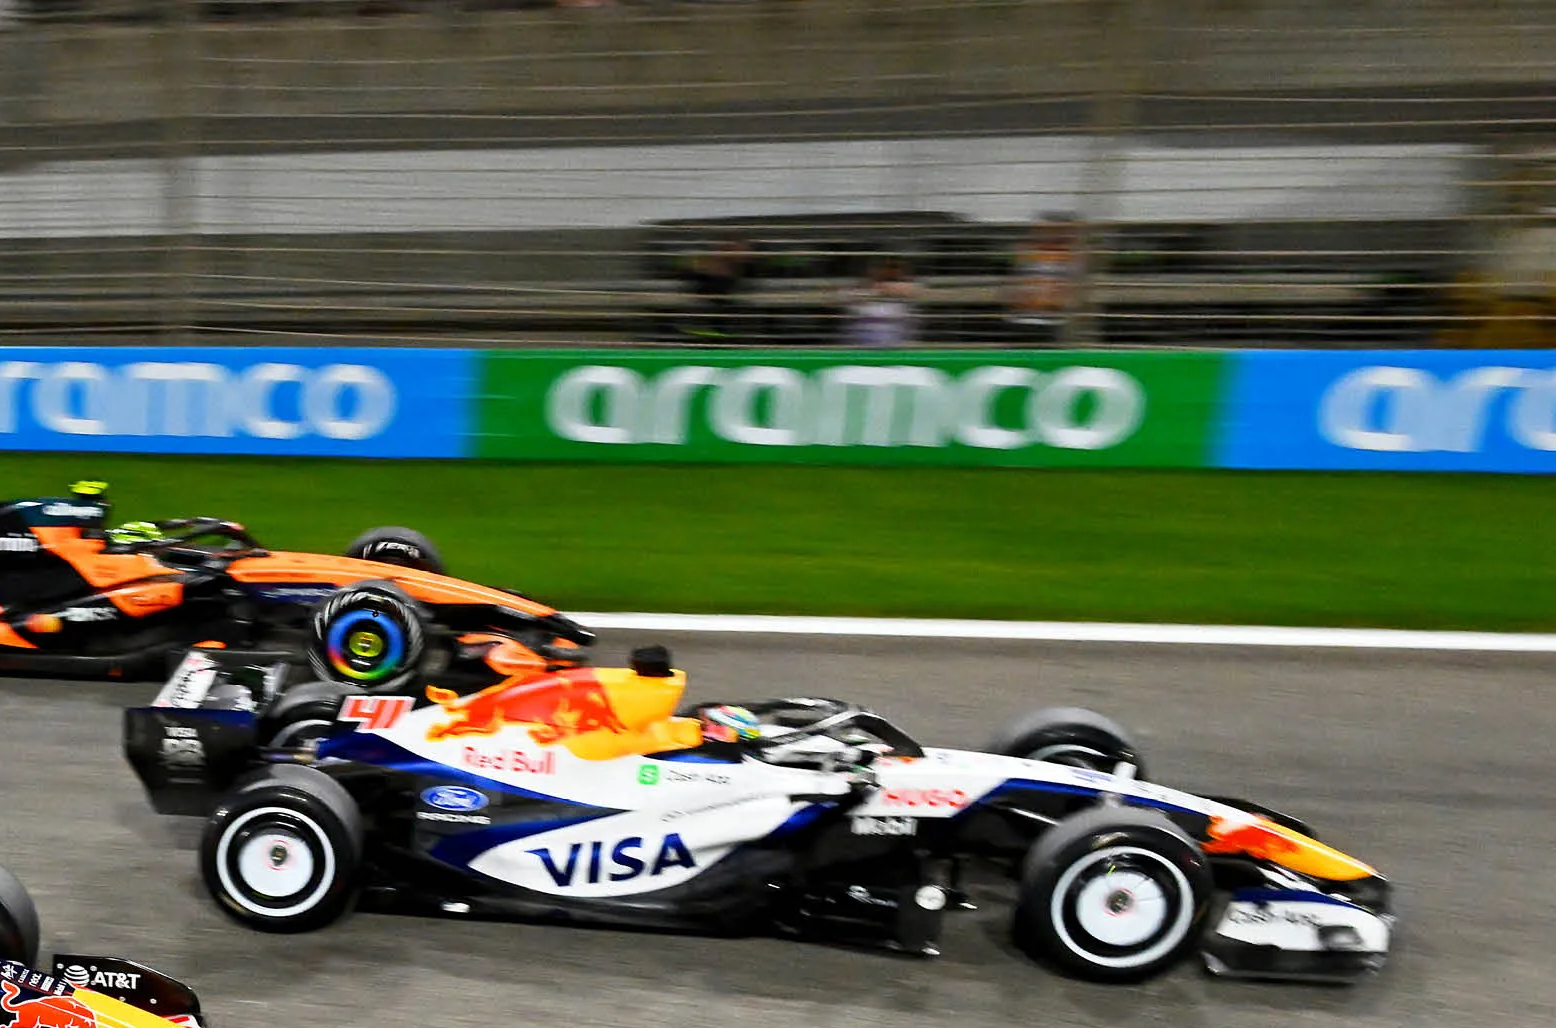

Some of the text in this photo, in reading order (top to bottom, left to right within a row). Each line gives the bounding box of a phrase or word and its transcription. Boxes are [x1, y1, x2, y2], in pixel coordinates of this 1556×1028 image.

[545, 365, 1147, 450] aramco
[524, 832, 695, 887] VISA
[93, 971, 141, 990] AT&T
